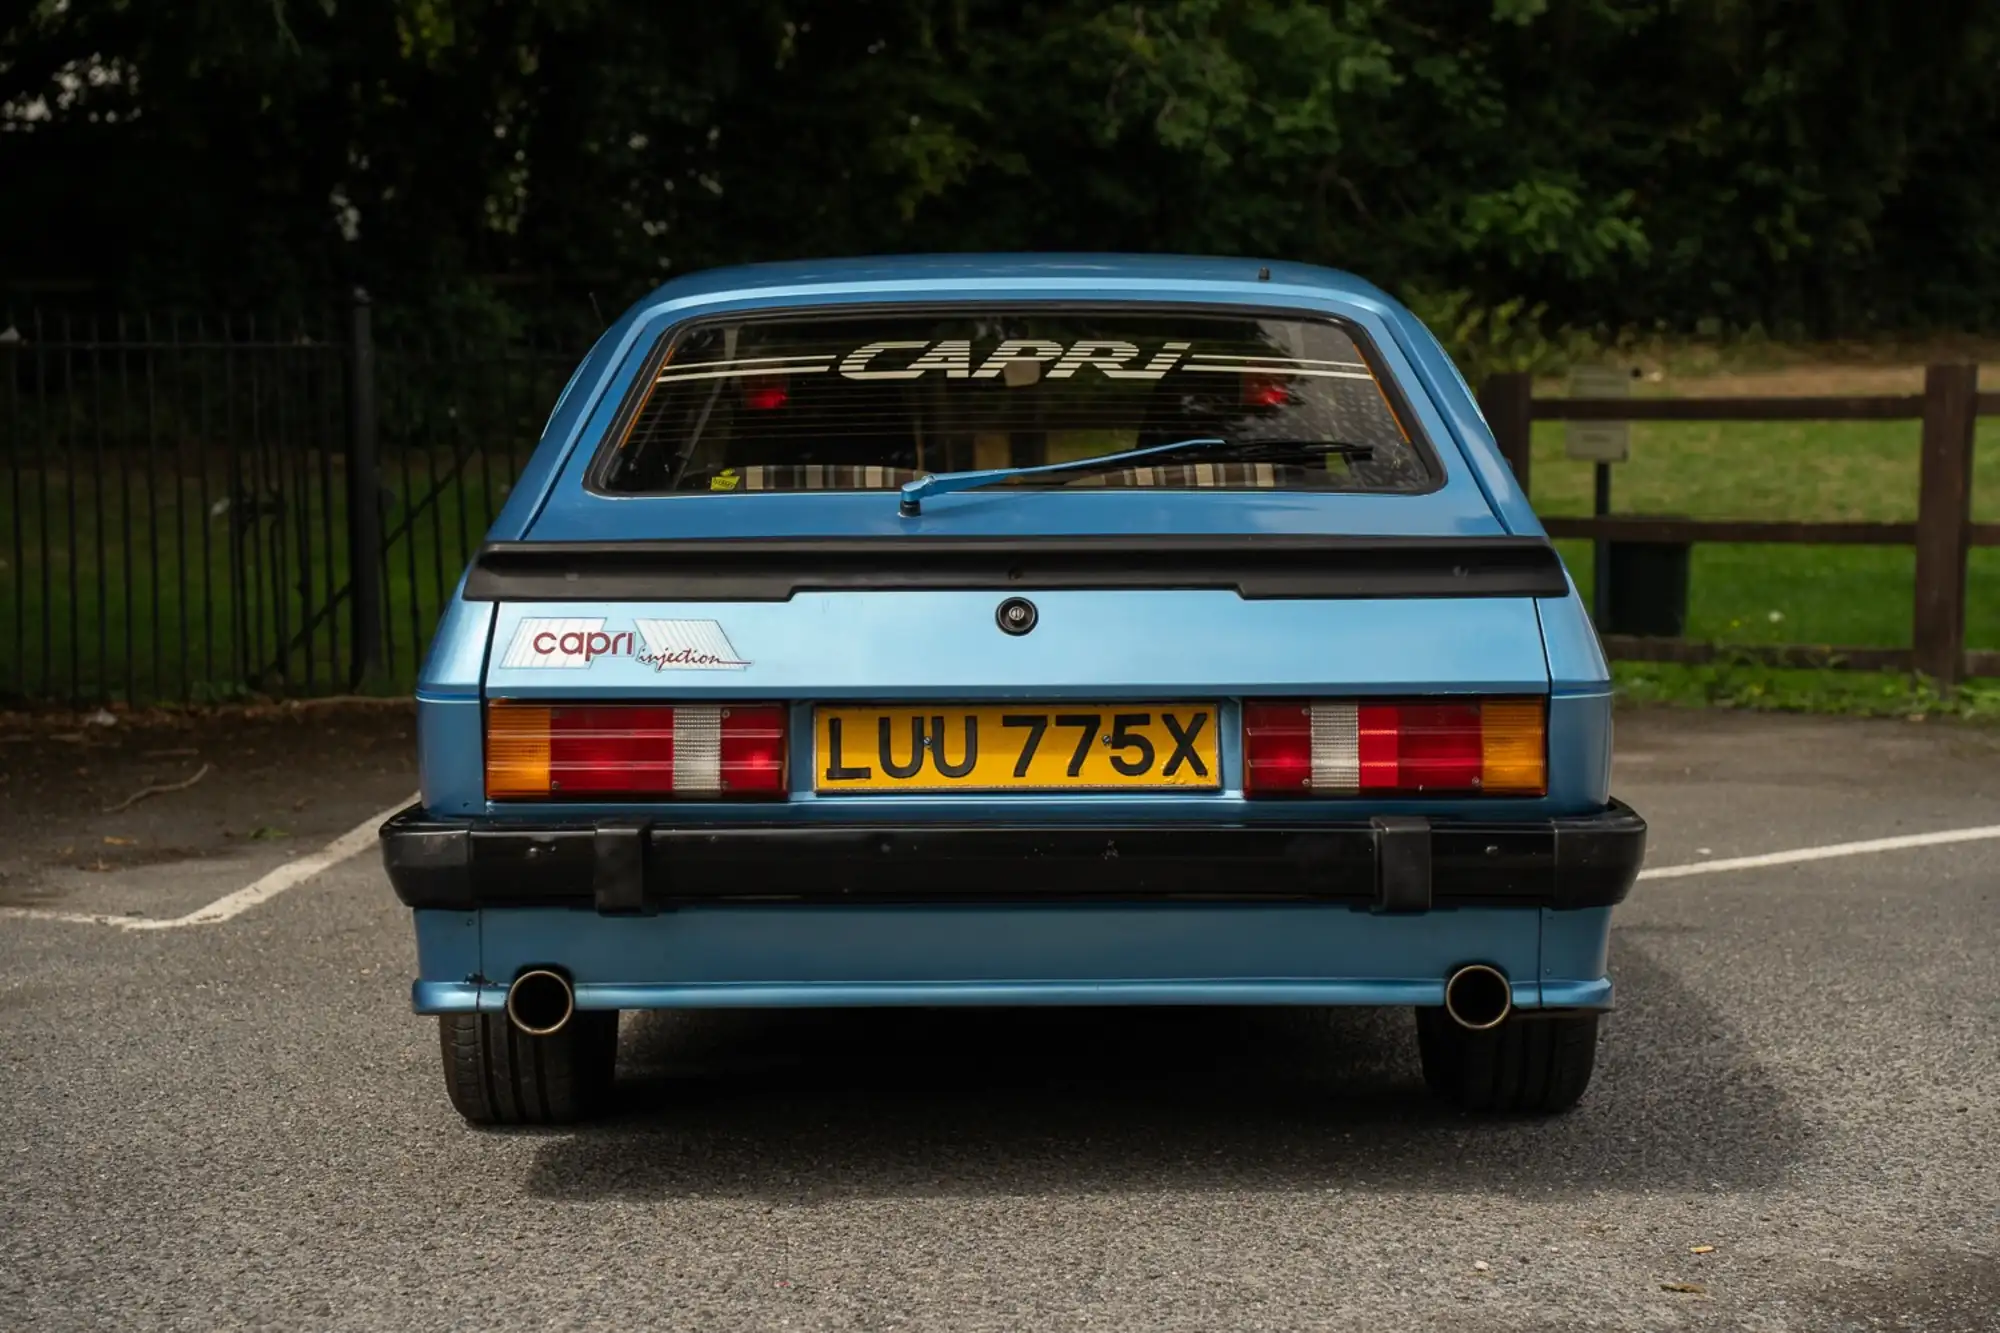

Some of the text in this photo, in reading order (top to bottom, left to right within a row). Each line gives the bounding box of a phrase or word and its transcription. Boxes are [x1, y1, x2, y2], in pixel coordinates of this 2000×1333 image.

[532, 631, 752, 671] capri injection
[826, 712, 1208, 780] LUU 775X
